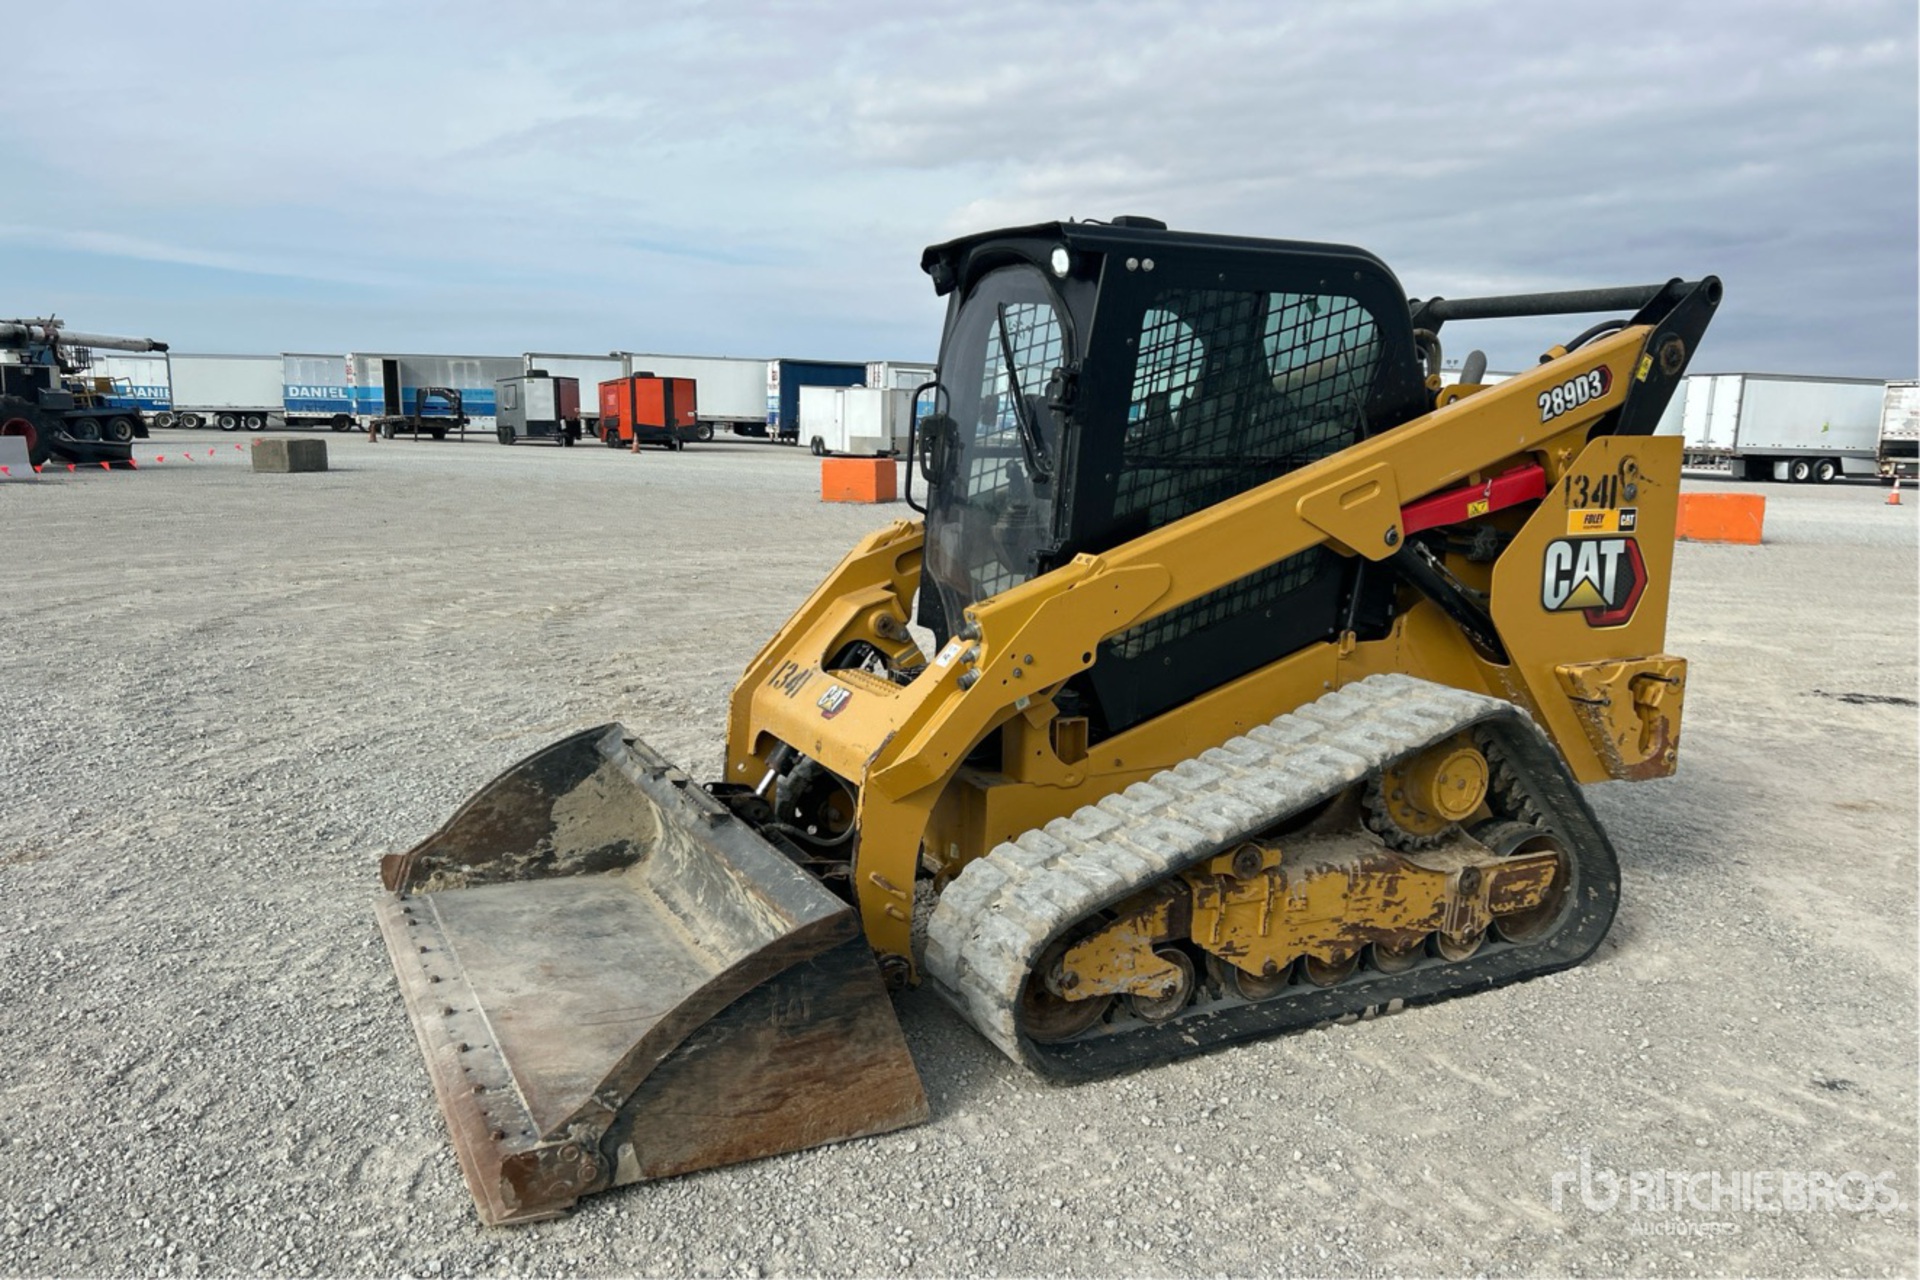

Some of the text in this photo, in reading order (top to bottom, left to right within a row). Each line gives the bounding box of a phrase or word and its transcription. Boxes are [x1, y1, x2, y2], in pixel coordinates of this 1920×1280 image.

[288, 386, 348, 398] DANIEL
[1538, 369, 1603, 422] 289D3
[1564, 474, 1618, 510] 1341
[1583, 513, 1635, 526] FOLEY CAT
[1543, 540, 1625, 610] CAT
[817, 685, 852, 713] CAT
